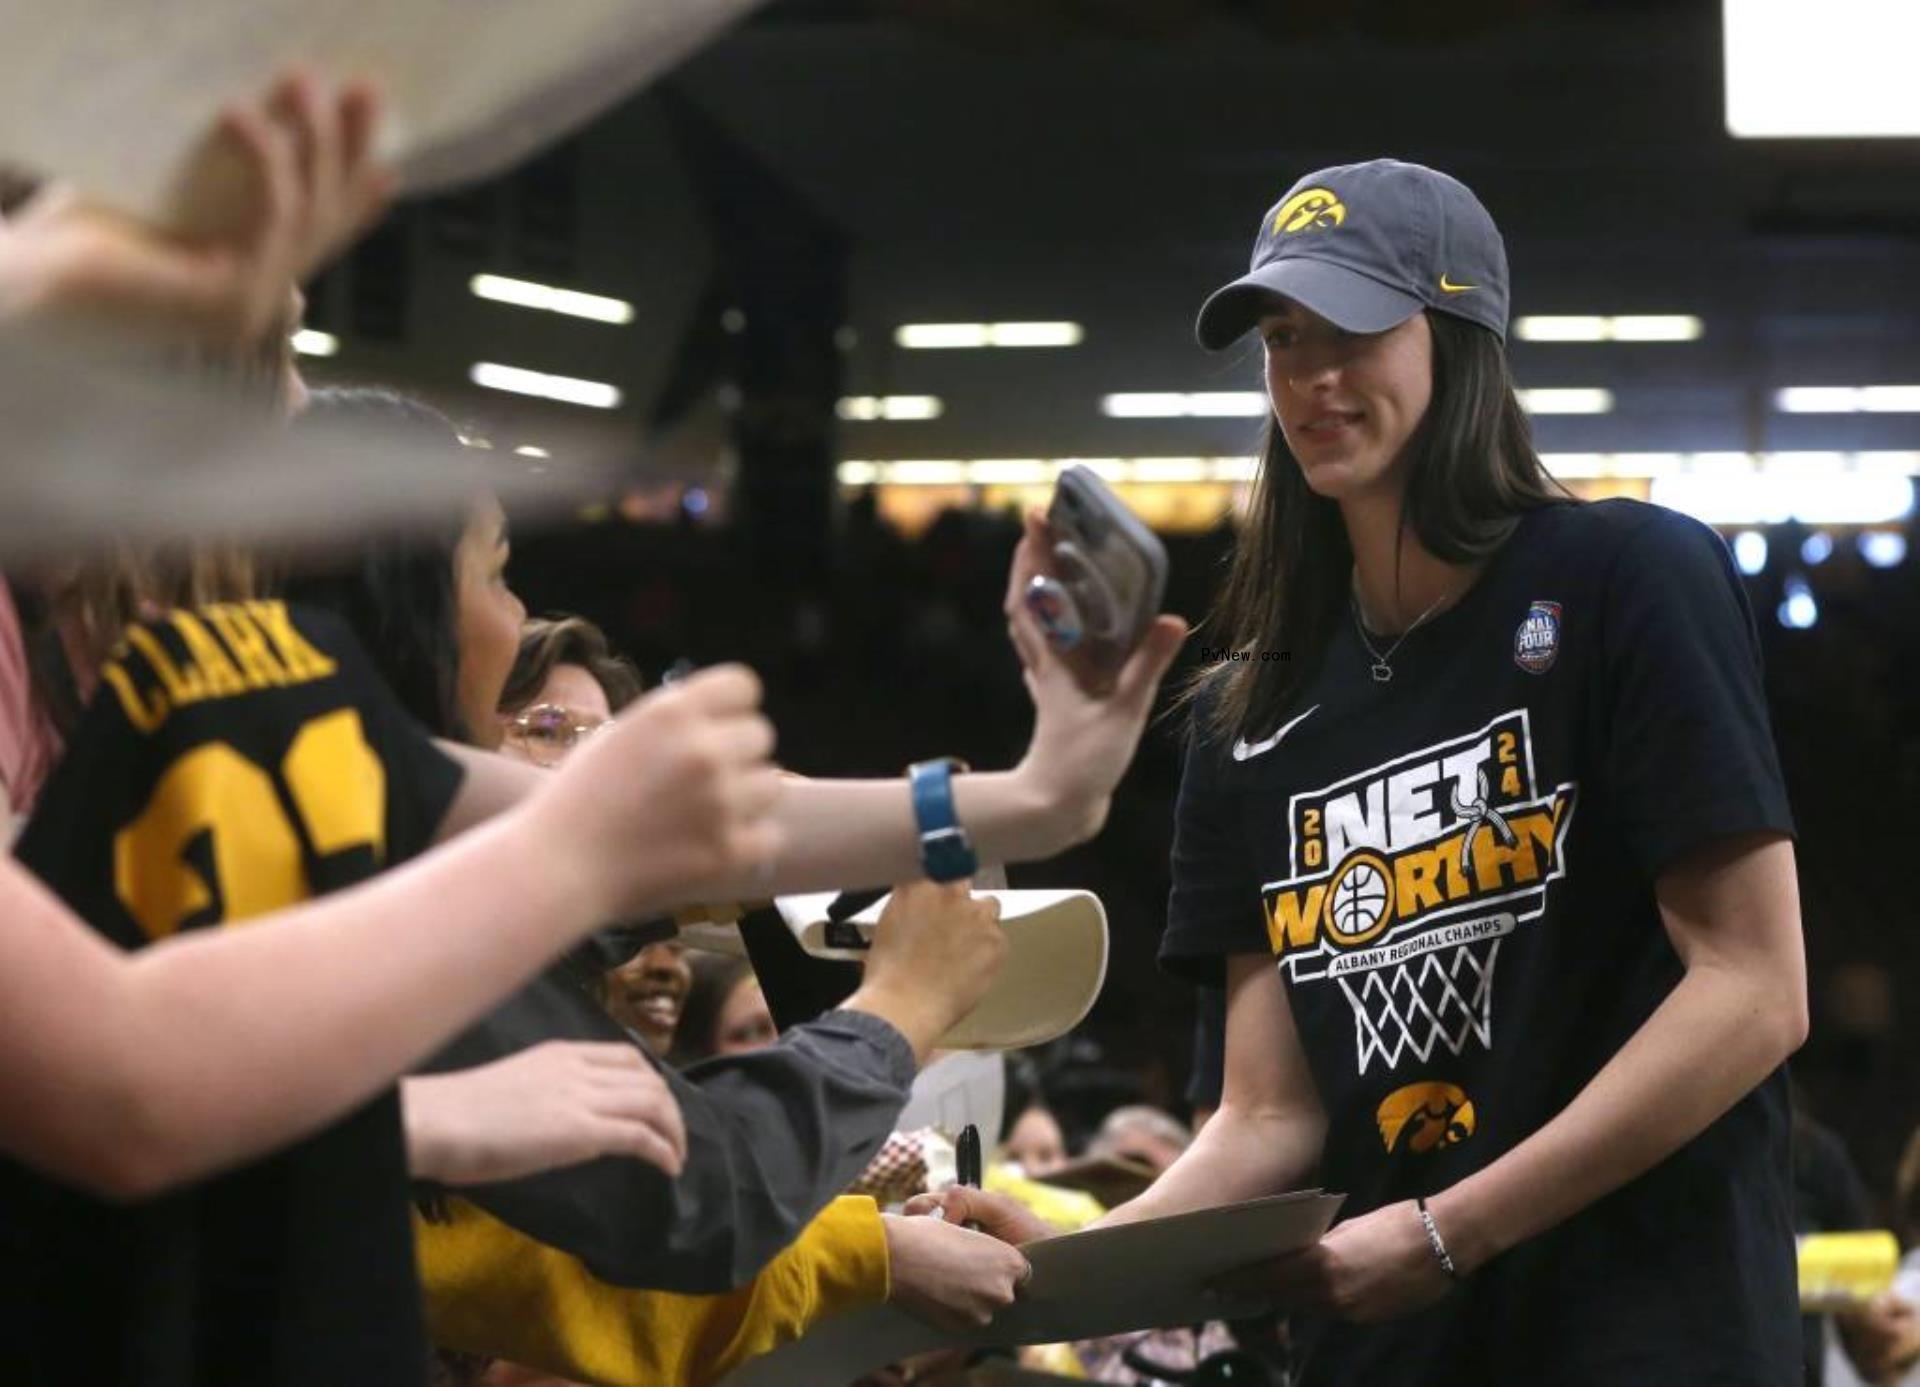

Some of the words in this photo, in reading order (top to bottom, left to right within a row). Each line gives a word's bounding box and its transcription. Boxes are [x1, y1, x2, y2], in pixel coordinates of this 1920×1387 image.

[1324, 736, 1492, 868] NET
[1262, 797, 1565, 954] WORTHY
[1335, 951, 1387, 972] ALBANY
[1390, 934, 1441, 961] REGIONAL
[1444, 919, 1502, 942] CHAMPS
